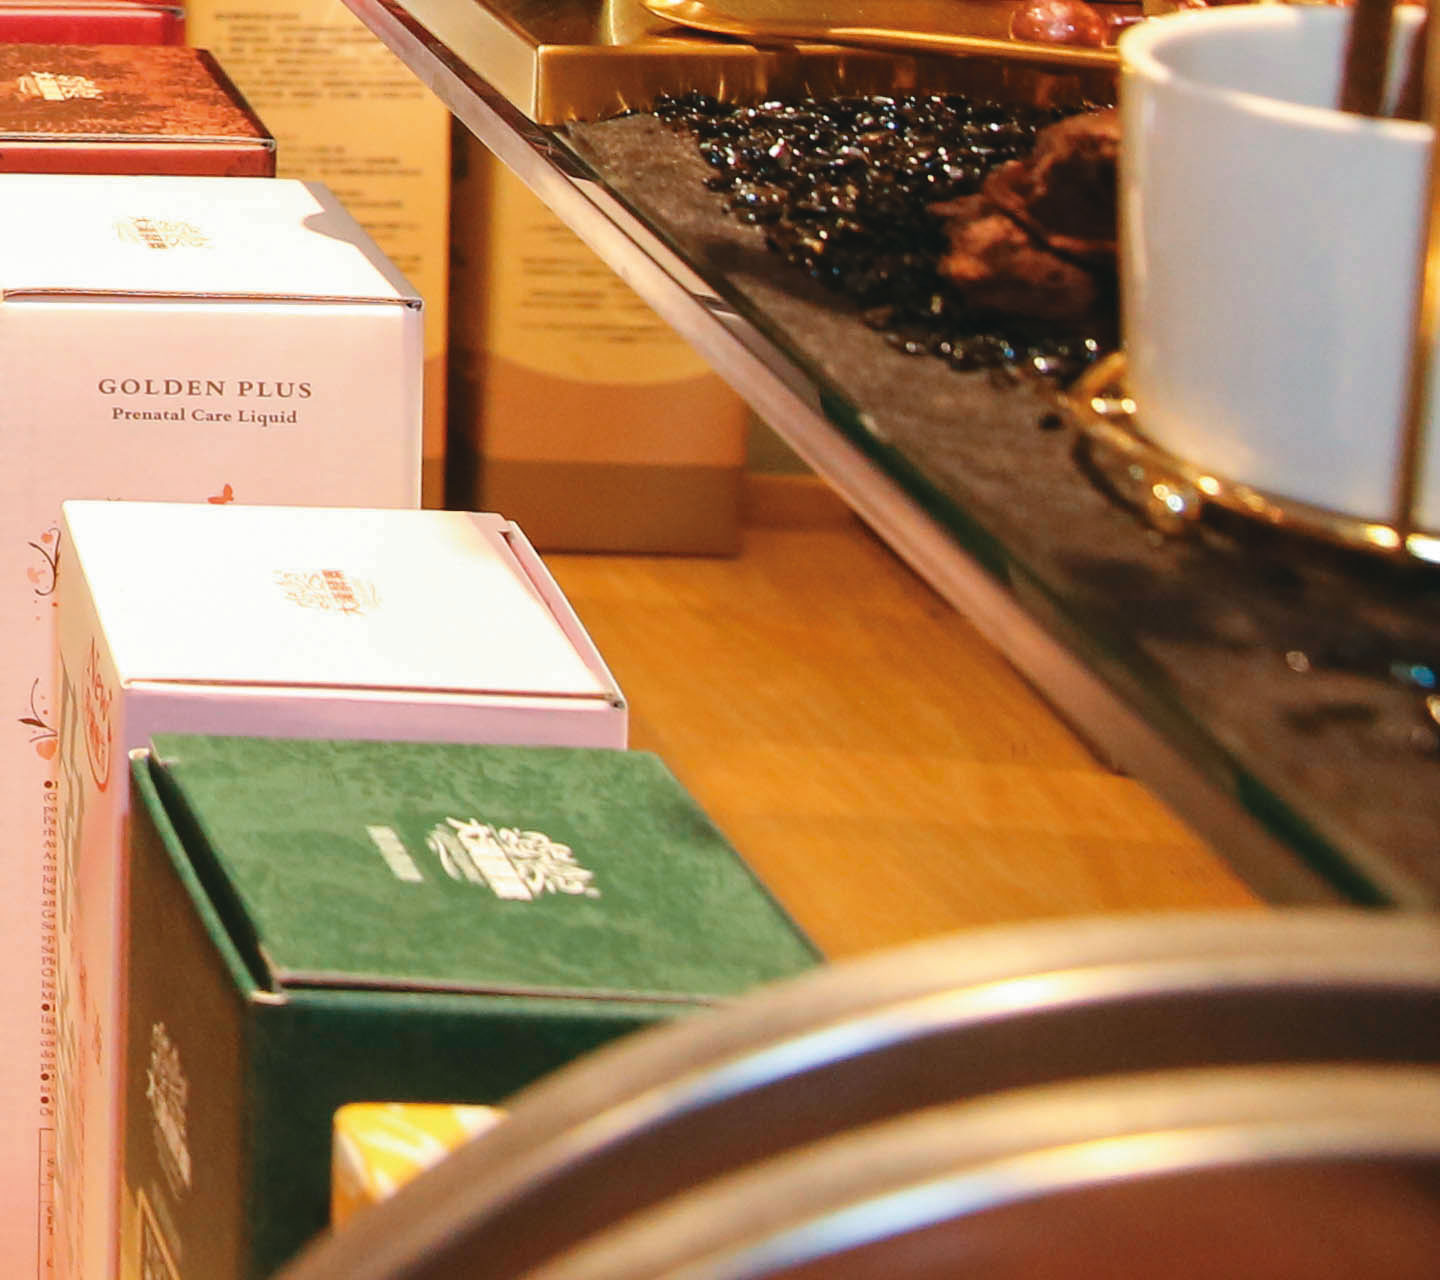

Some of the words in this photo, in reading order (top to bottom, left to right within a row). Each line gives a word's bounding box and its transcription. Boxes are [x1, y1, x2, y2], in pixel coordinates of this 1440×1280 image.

[98, 378, 226, 397] GOLDEN
[237, 380, 313, 399] PLUS
[112, 407, 186, 422] Prenatal
[191, 408, 232, 423] Care
[238, 409, 298, 427] Liquid
